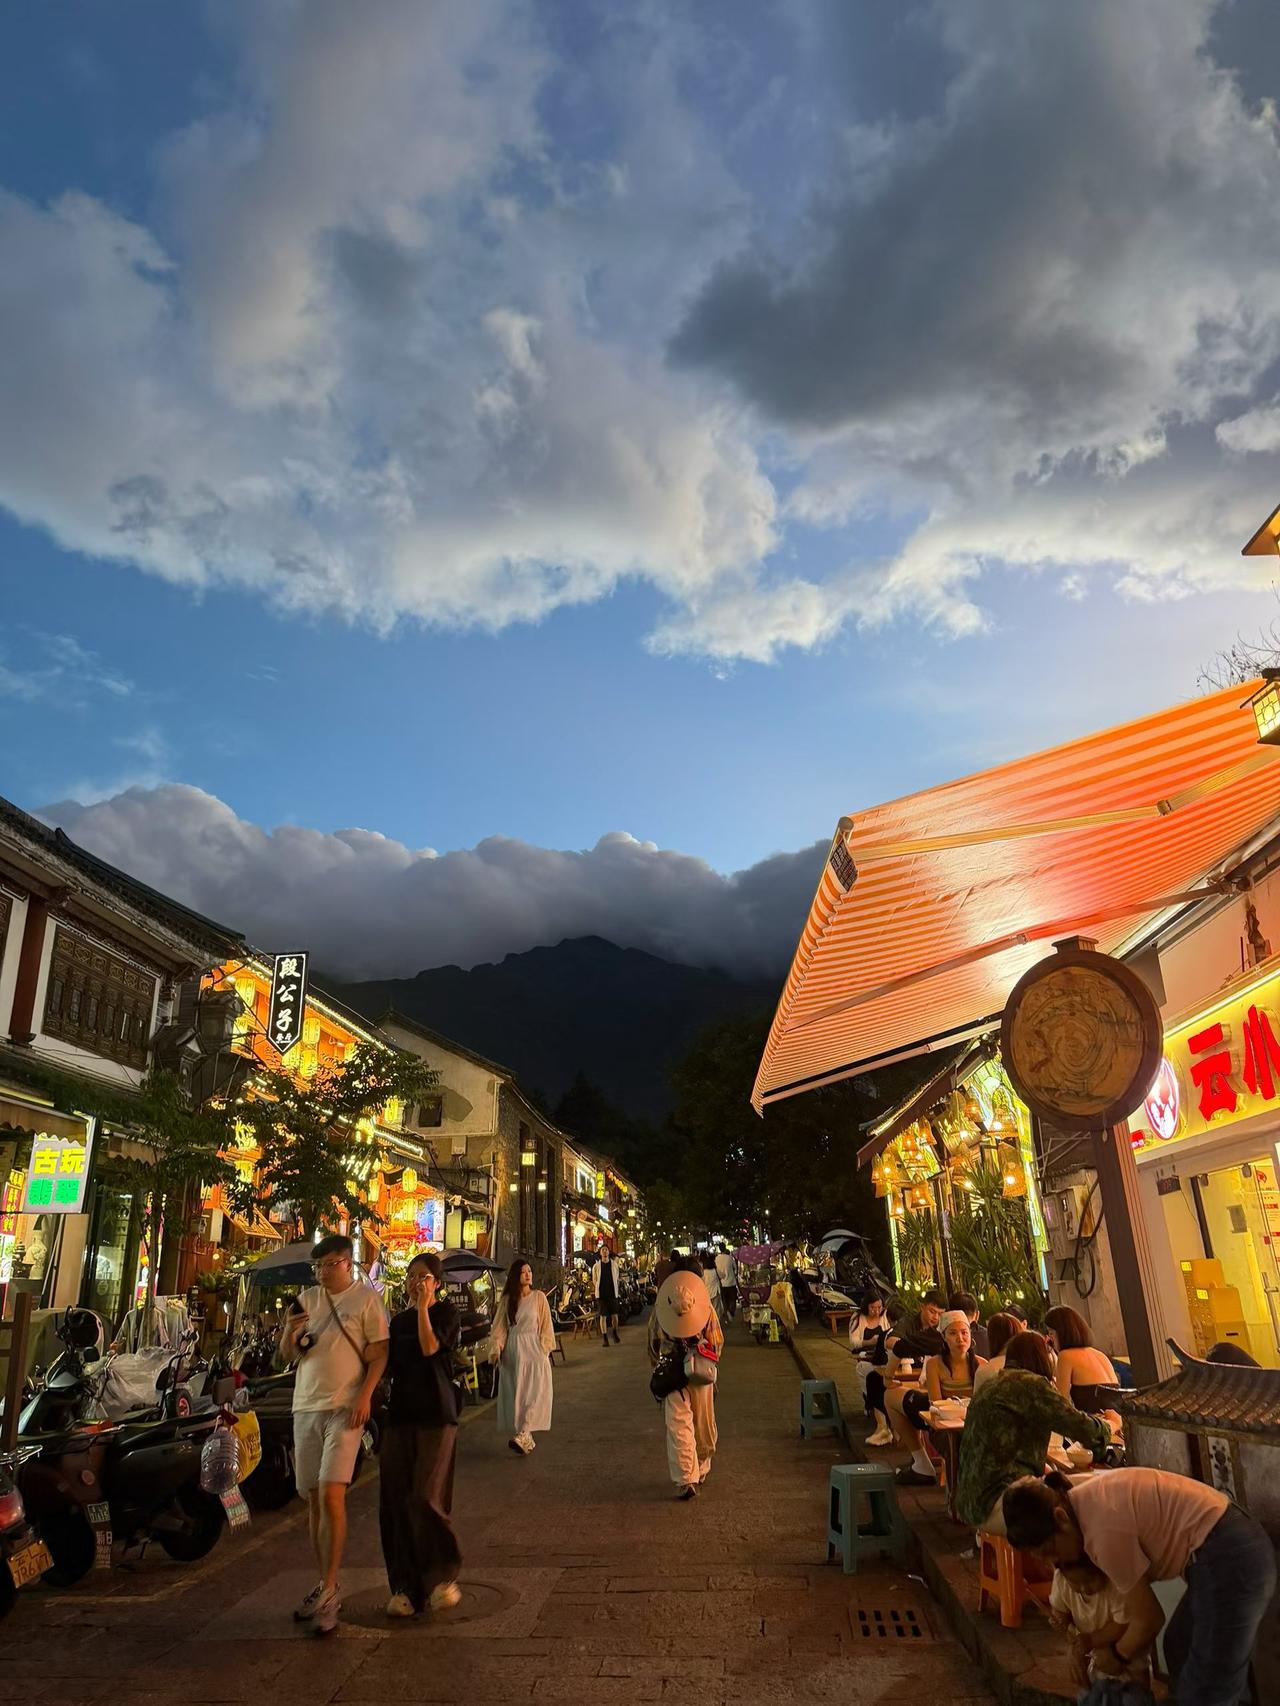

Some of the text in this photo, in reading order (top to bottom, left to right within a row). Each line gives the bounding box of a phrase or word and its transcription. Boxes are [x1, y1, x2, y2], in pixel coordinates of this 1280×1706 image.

[276, 958, 301, 1032] 段公子
[33, 1147, 86, 1174] 古玩
[28, 1179, 80, 1205] 翡翠
